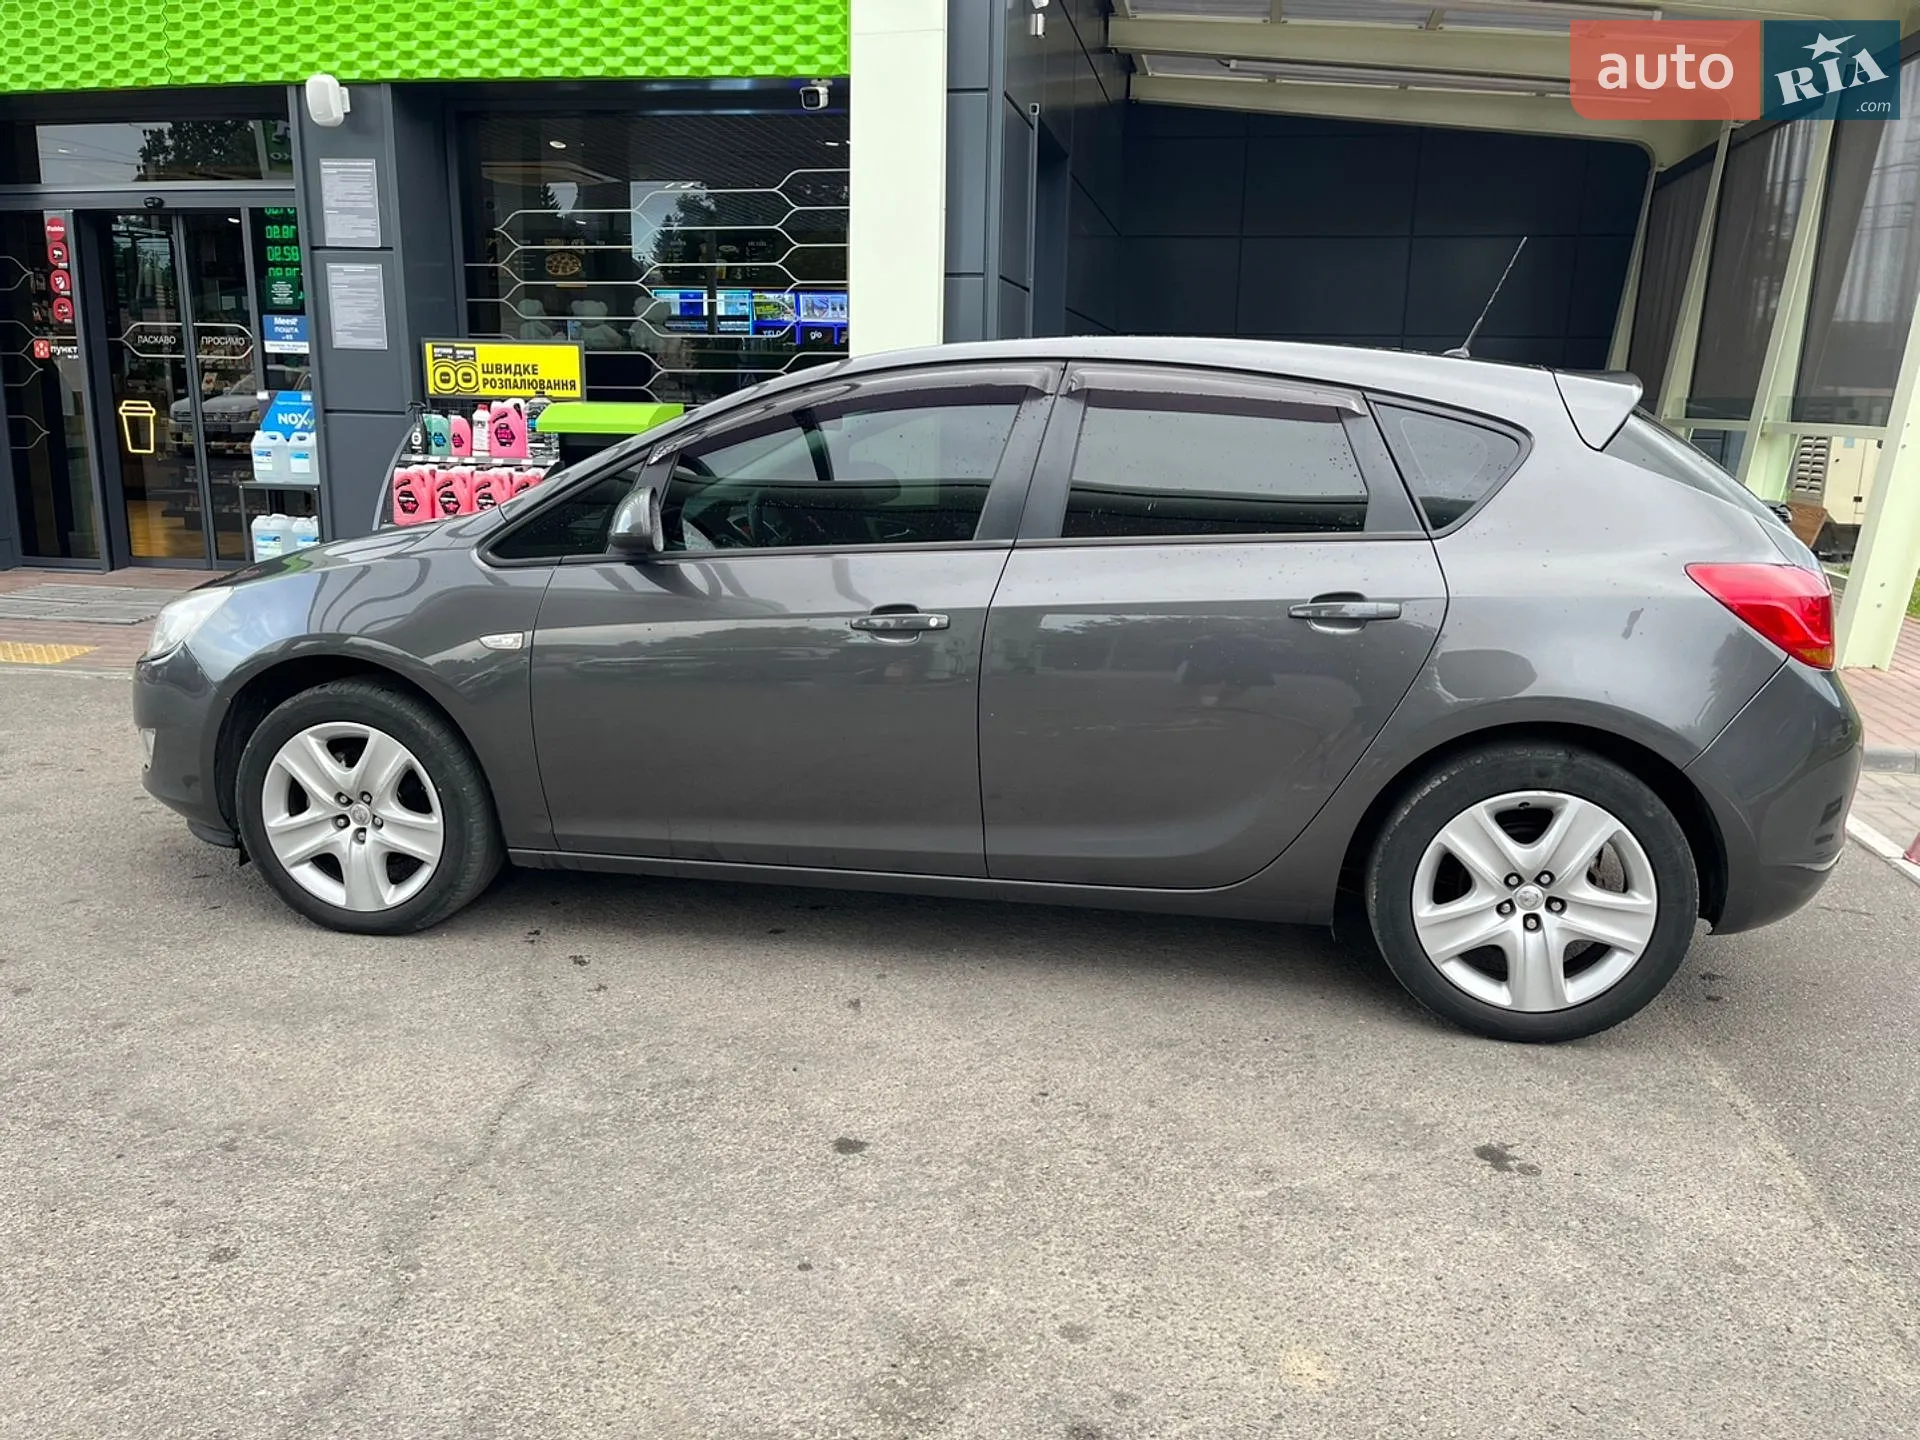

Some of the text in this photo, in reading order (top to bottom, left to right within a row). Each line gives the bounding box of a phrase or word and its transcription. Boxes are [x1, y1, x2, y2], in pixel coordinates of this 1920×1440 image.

[201, 336, 246, 346] ПРОСИМО
[481, 363, 539, 376] ШВИДКЕ
[482, 378, 577, 391] РОЗПАЛЮВАННЯ
